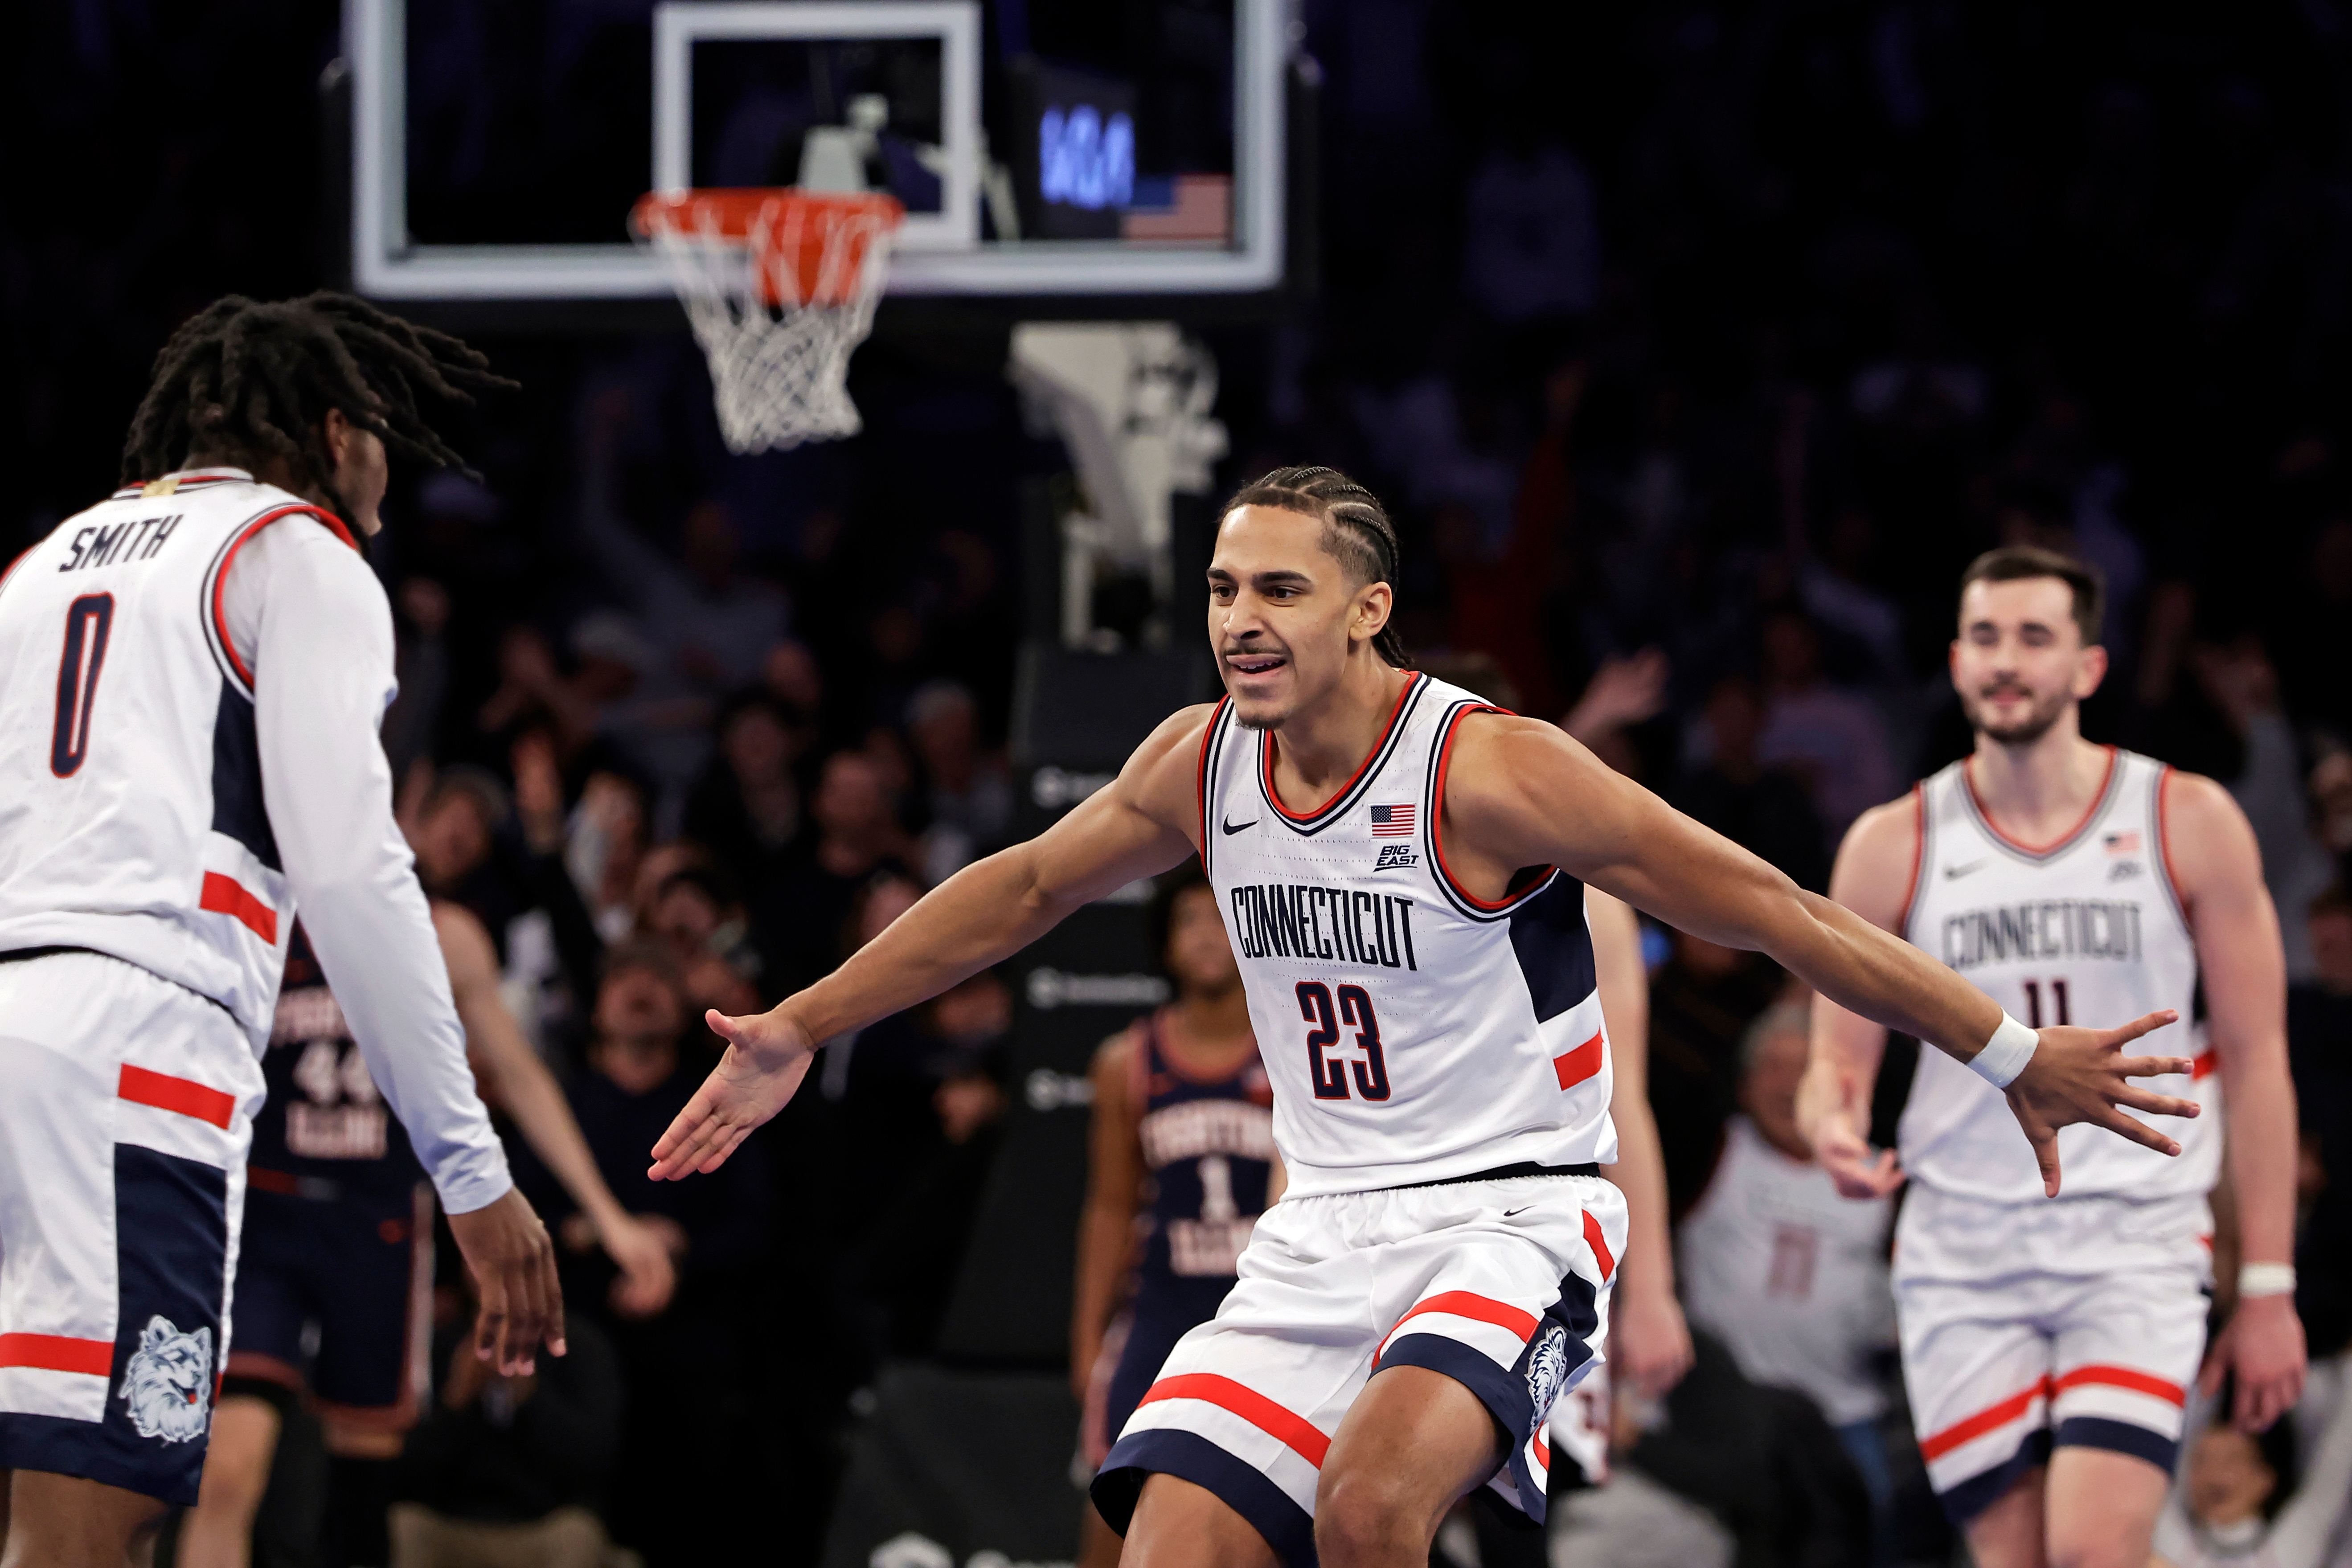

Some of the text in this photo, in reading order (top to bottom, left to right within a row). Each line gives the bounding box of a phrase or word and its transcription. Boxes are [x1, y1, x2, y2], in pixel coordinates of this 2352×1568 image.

[58, 514, 184, 573] SMITH
[50, 591, 115, 779] 0
[1376, 855, 1419, 866] EAST
[1380, 845, 1410, 856] BIG
[1231, 884, 1417, 971] CONNECTICUT
[1295, 981, 1390, 1101] 23
[1200, 1155, 1239, 1222] 1
